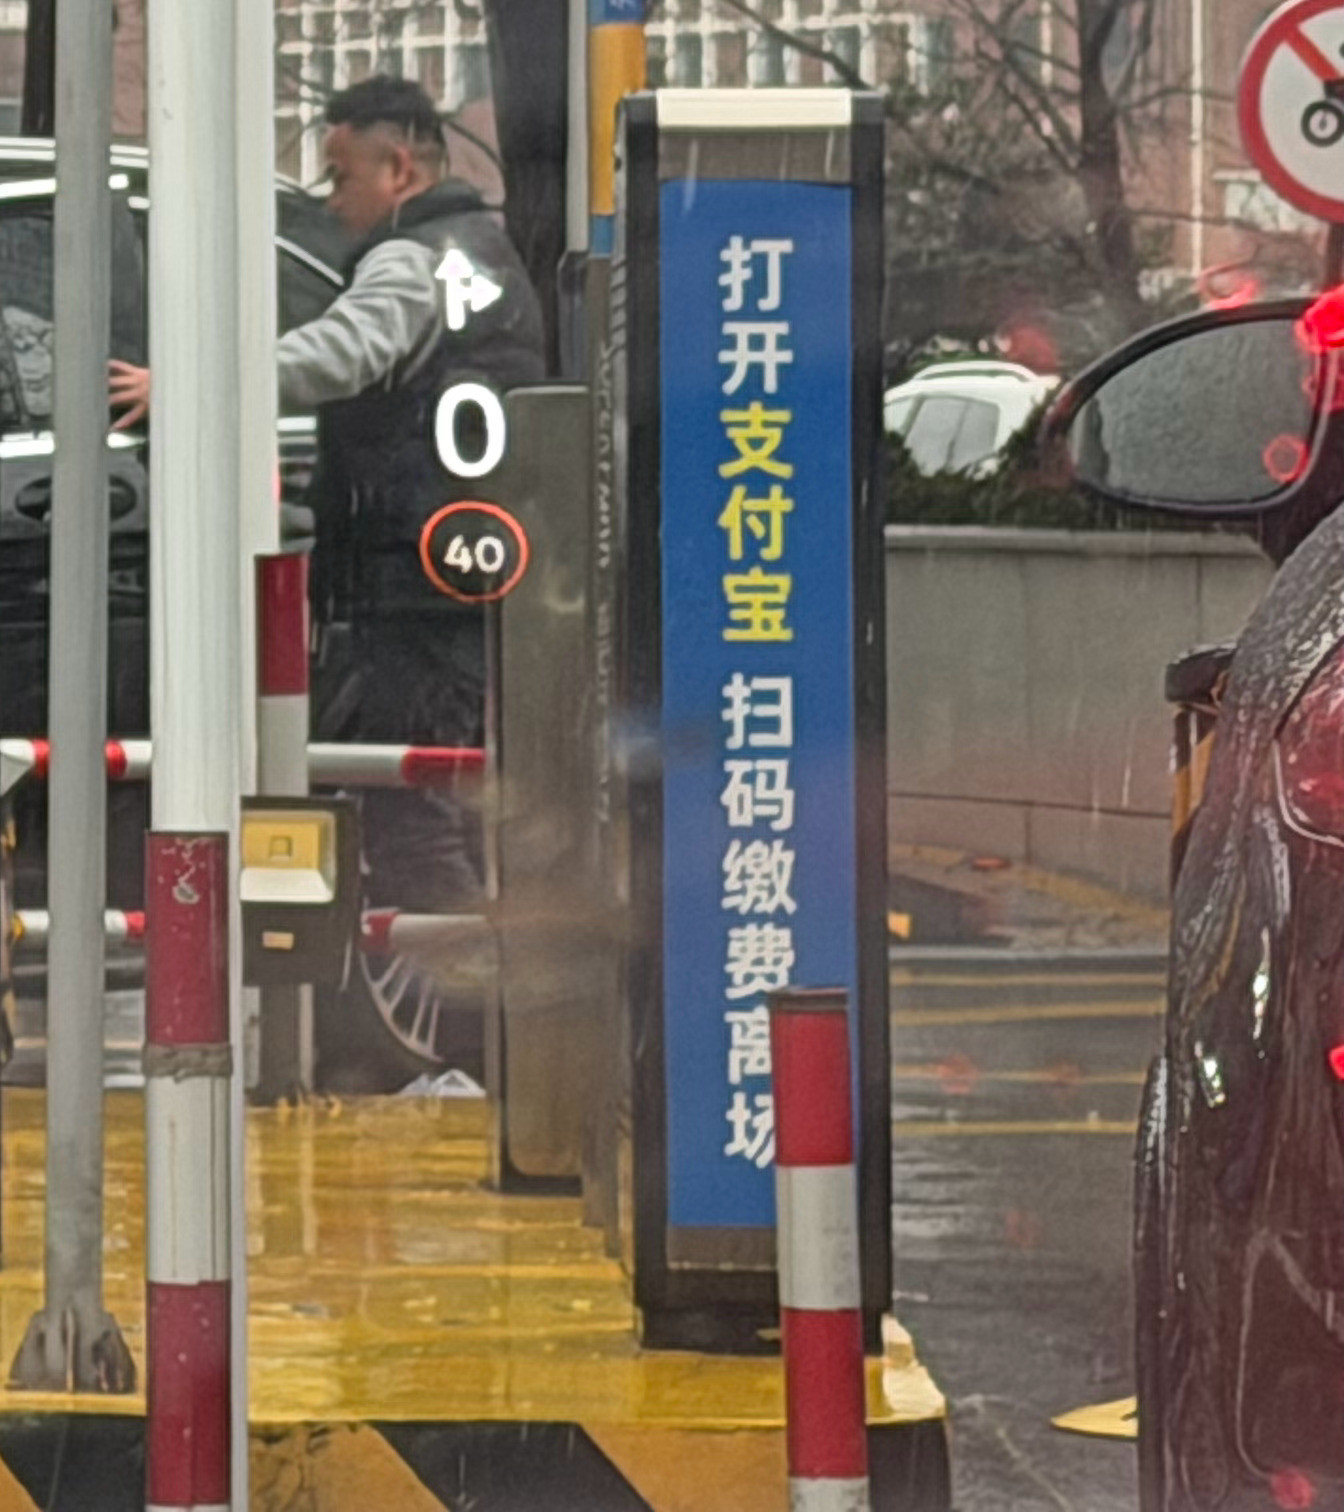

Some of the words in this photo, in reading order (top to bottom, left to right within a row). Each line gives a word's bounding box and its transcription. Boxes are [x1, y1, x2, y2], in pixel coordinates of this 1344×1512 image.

[435, 383, 506, 478] 0
[718, 236, 794, 642] 打开支付宝
[443, 535, 505, 573] 40
